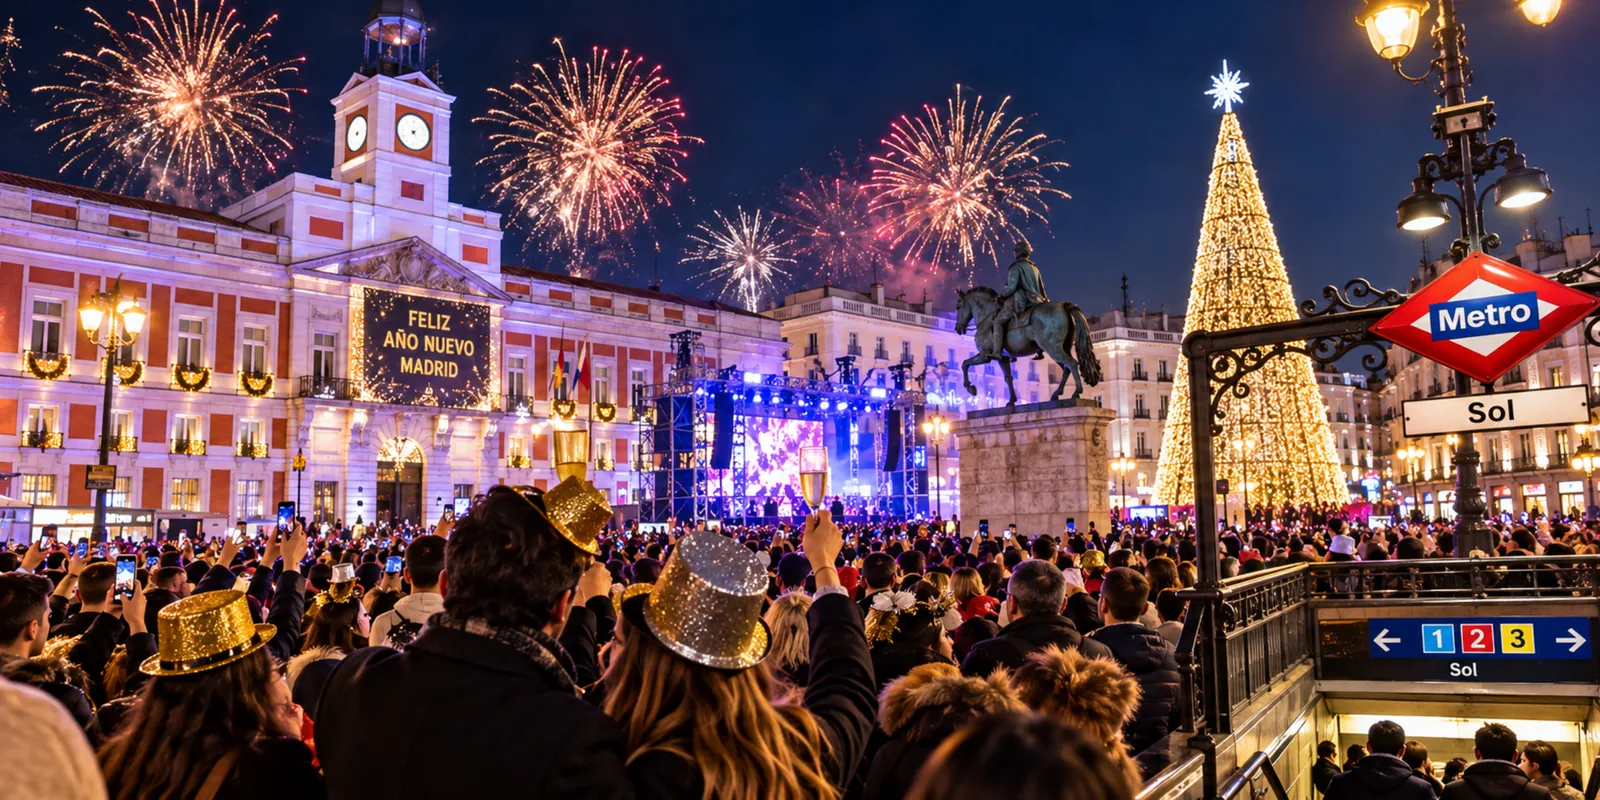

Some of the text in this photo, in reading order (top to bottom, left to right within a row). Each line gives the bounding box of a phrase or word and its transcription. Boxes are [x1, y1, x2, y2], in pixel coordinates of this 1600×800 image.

[408, 309, 451, 331] FELIZ
[1438, 303, 1531, 332] Metro
[383, 328, 475, 357] AÑO NUEVO
[400, 356, 459, 378] MADRID
[1468, 399, 1515, 424] Sol
[1432, 629, 1526, 649] 1 2 3
[1450, 662, 1478, 677] Sol
